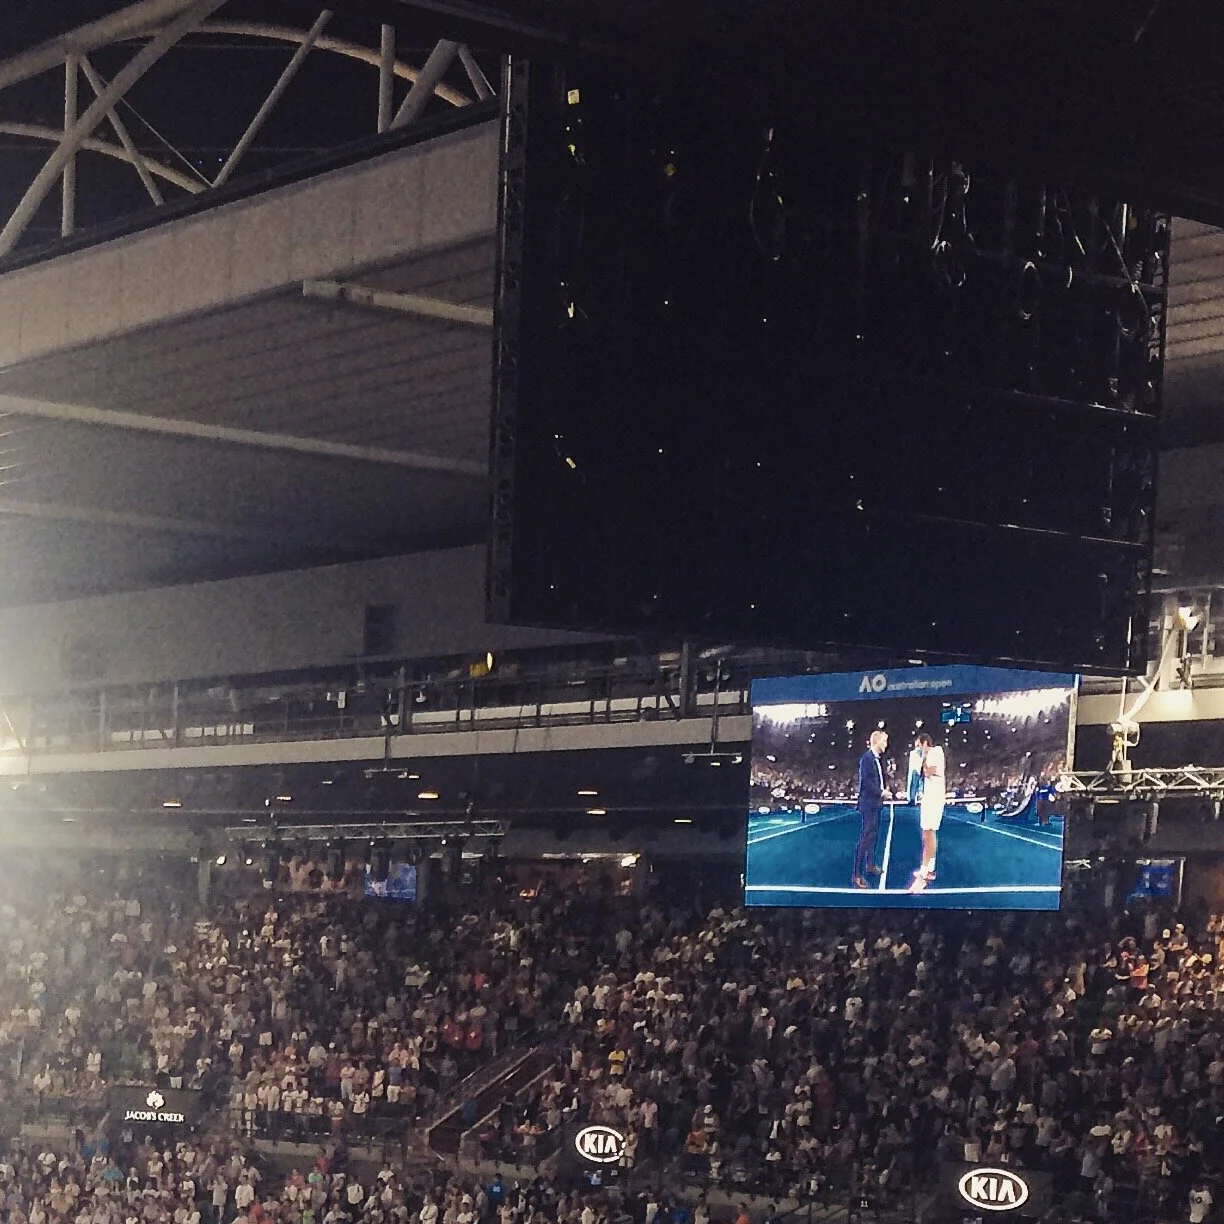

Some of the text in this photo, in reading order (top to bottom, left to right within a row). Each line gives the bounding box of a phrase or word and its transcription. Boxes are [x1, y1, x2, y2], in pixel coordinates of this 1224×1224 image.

[859, 674, 887, 692] AO
[158, 1112, 184, 1122] CREEK
[584, 1133, 617, 1153] KIA
[970, 1176, 1016, 1203] KIA
